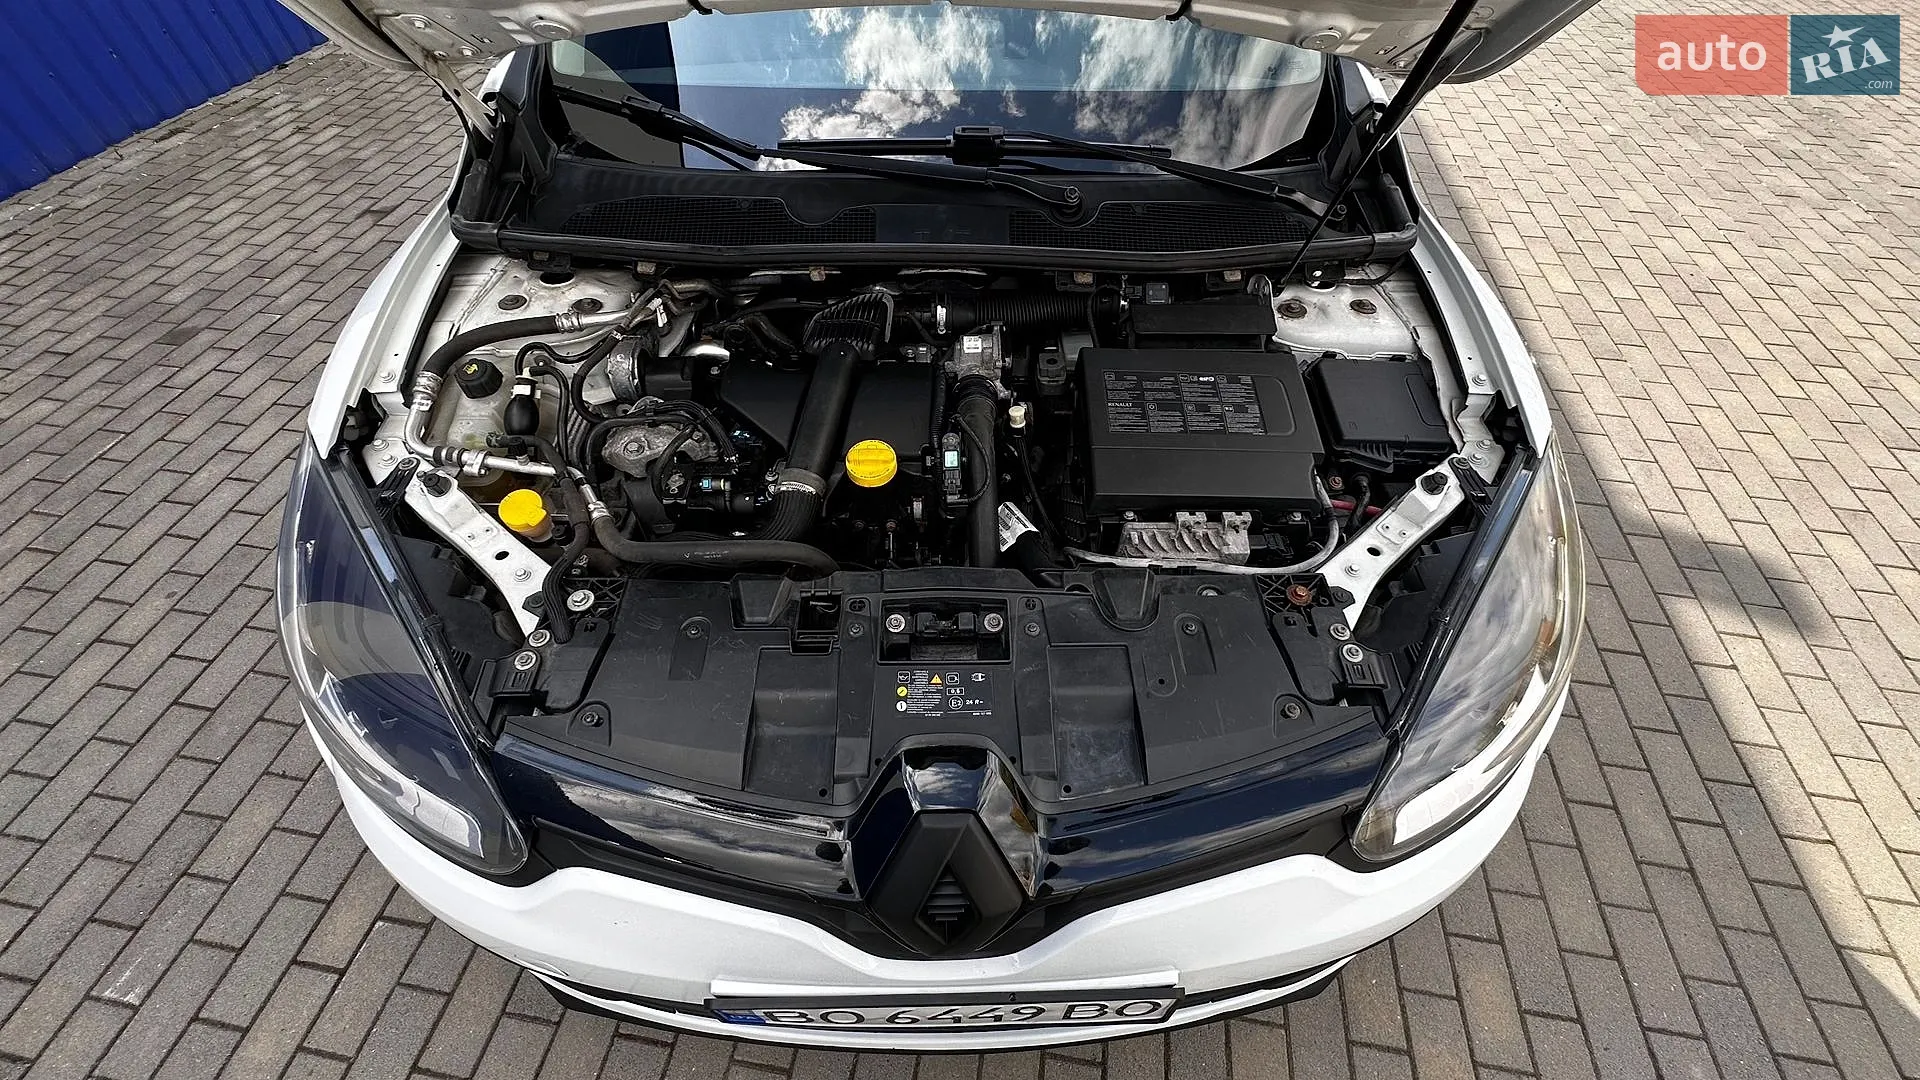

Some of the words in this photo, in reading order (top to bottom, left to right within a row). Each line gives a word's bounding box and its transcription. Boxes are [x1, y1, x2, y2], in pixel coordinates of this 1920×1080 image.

[763, 1010, 865, 1024] BO
[886, 1005, 1046, 1024] 6449
[1061, 1001, 1162, 1020] BO
